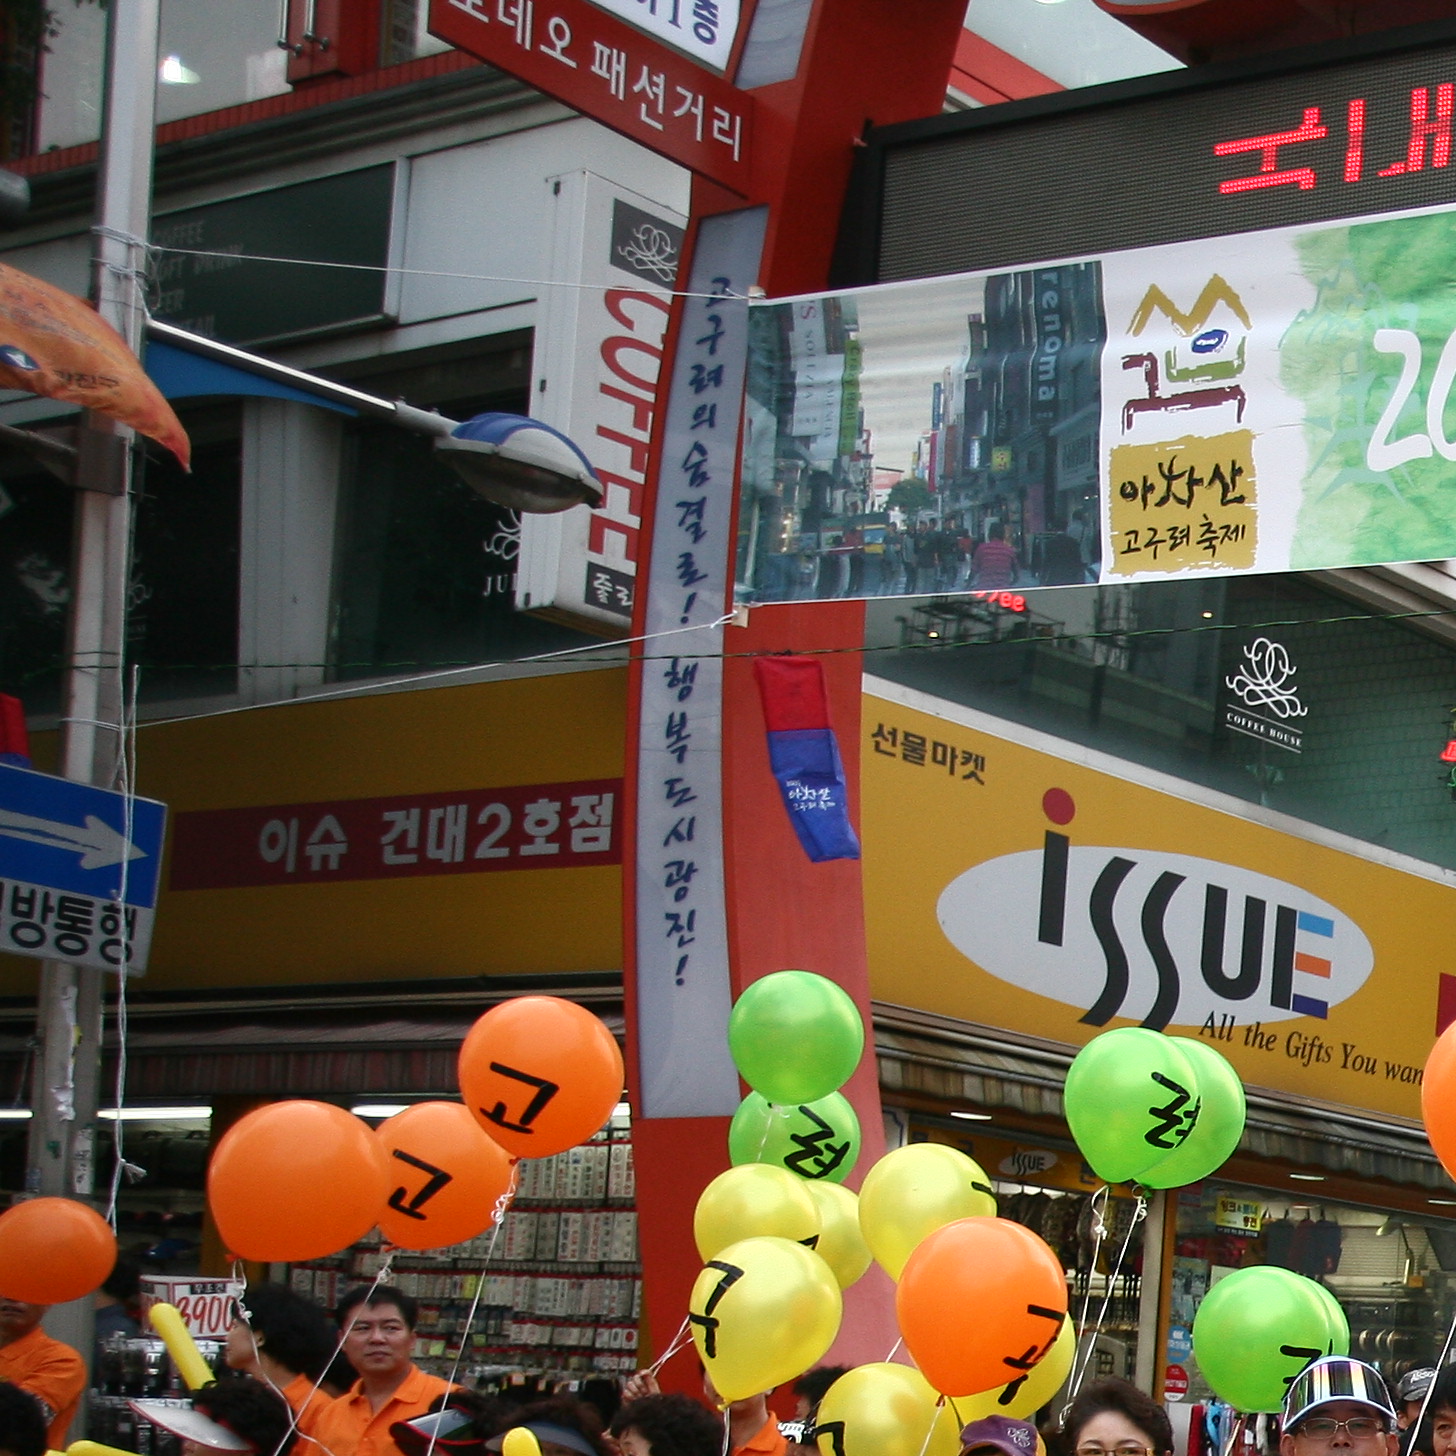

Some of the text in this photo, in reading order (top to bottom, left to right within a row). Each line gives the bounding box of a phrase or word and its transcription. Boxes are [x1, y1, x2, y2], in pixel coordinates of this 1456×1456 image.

[591, 41, 742, 163] 패션거리
[689, 276, 732, 431] 고구려의
[1119, 454, 1247, 511] 아차산
[1119, 513, 1247, 562] 고구려 축제
[662, 656, 700, 849] 행복도시
[870, 721, 988, 787] 선물마켓
[1226, 711, 1266, 735] COFFEE
[259, 792, 616, 874] 이슈 건대2호점
[0, 885, 138, 967] 방통행
[1199, 1010, 1424, 1088] All the Gifts You wan
[478, 1060, 561, 1135] 고
